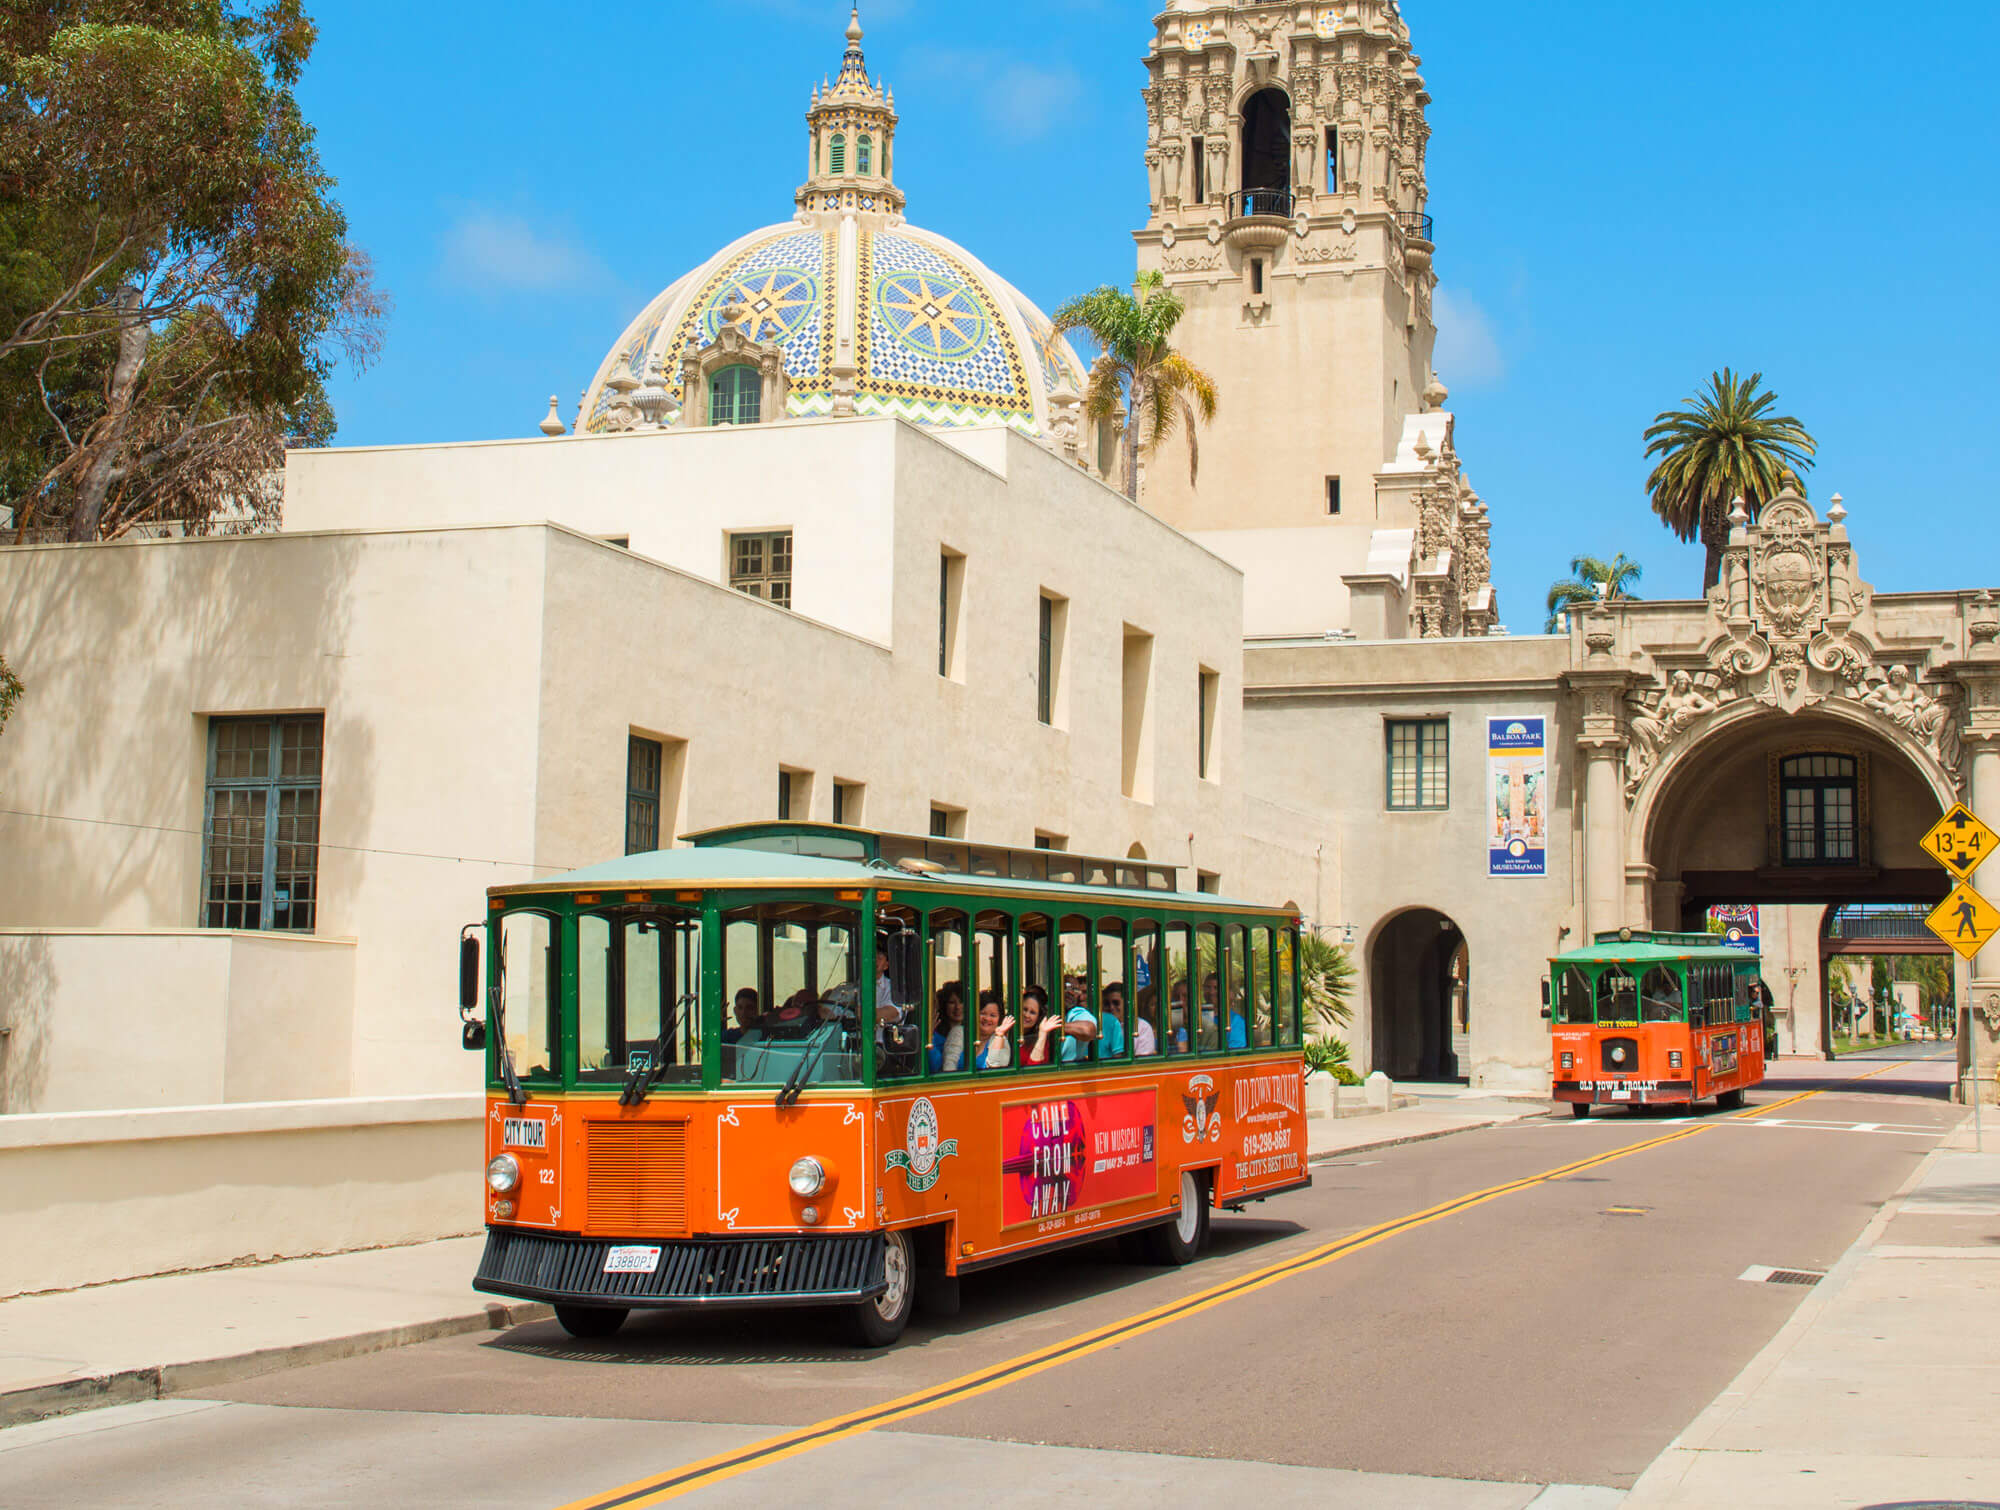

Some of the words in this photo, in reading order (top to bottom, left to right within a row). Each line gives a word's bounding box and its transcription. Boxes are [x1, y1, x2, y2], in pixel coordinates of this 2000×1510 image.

[1491, 733, 1520, 741] BALBOA
[1597, 1020, 1614, 1028] CITY
[1615, 1020, 1638, 1028] TOURS
[1579, 1081, 1594, 1091] OLD
[1596, 1080, 1619, 1091] TOWN
[1622, 1080, 1658, 1091] TROLLEY
[1234, 1079, 1249, 1124] OLD
[1250, 1076, 1271, 1110] TOWN
[1271, 1073, 1300, 1115] TROLLEY
[504, 1119, 522, 1145] CITY
[523, 1120, 544, 1146] TOUR
[1031, 1103, 1069, 1140] COME
[1094, 1131, 1109, 1154] NEW
[1243, 1127, 1291, 1157] 619-298-8687
[888, 1152, 904, 1162] SEE
[1033, 1142, 1071, 1179] FROM
[1235, 1162, 1249, 1180] THE
[1249, 1158, 1267, 1177] CITY'S
[1268, 1156, 1282, 1173] BEST
[1282, 1152, 1299, 1170] TOUR
[539, 1169, 555, 1185] 122
[908, 1174, 922, 1189] THE
[922, 1166, 939, 1188] BEST
[1031, 1180, 1071, 1218] AWAY
